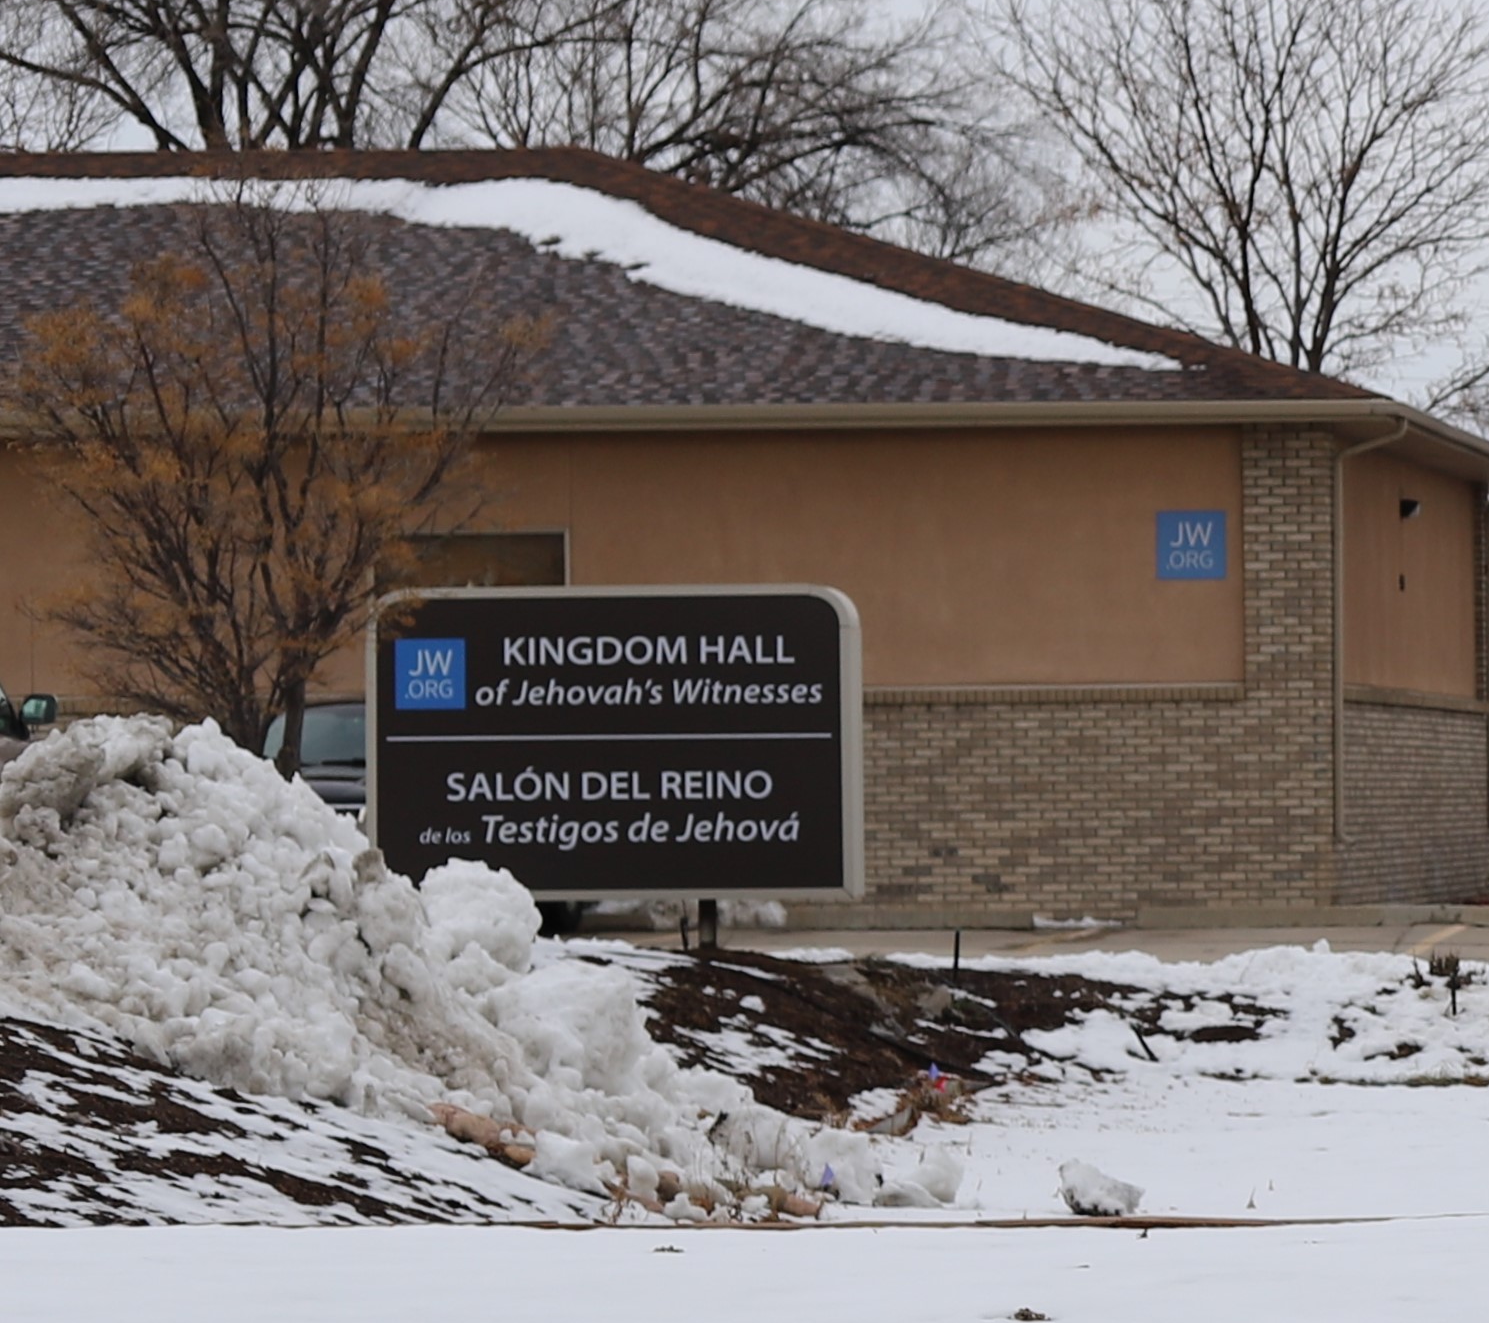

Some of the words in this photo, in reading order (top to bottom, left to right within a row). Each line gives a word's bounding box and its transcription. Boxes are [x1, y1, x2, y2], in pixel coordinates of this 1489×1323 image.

[1169, 521, 1212, 548] JW
[1166, 550, 1213, 570] .ORG
[408, 649, 453, 676] JW
[503, 635, 688, 666] KINGDOM
[700, 634, 795, 664] HALL
[404, 680, 453, 699] .ORG
[475, 680, 509, 707] of
[673, 680, 823, 706] Witnesses
[446, 766, 569, 802] SALÓN
[582, 772, 650, 801] DEL
[660, 770, 772, 800] REINO
[419, 827, 443, 844] de
[446, 827, 471, 844] los
[481, 815, 619, 851] Testigos
[627, 814, 670, 843] de
[676, 812, 800, 844] Jehová
